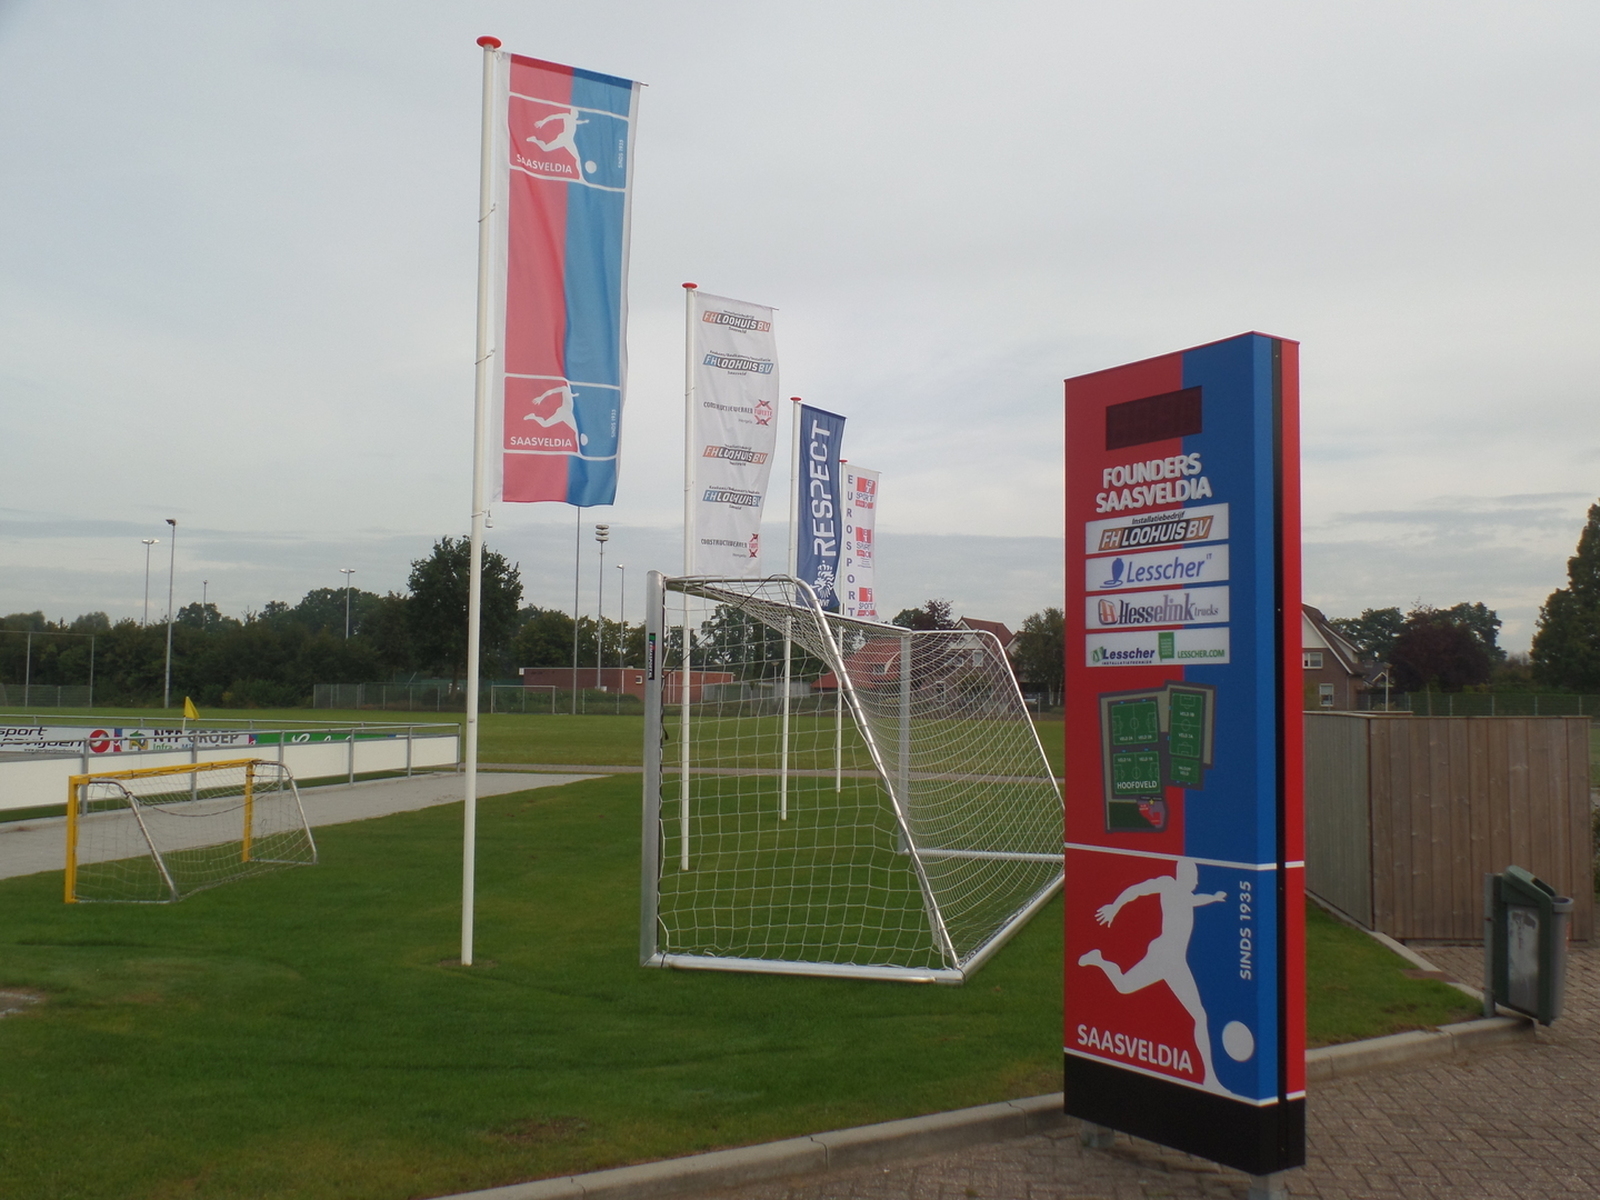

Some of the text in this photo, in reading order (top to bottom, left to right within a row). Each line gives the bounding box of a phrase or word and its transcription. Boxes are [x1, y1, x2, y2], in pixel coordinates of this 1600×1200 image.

[516, 154, 573, 174] SAASVELDIA
[510, 436, 572, 447] SAASVELDIA
[1103, 452, 1202, 489] FOUNDERS
[809, 419, 836, 556] RESPECT
[1096, 476, 1213, 514] SAASVELDIA
[1131, 511, 1186, 525] Installatiebedrijf
[1126, 556, 1205, 584] Lesscher
[1118, 593, 1219, 624] Hesselink trucks
[1103, 647, 1155, 660] Lesscher
[1177, 649, 1225, 659] LESSCHER.COM
[153, 729, 184, 743] NTP
[1117, 781, 1157, 789] HOOFDVELD
[1239, 881, 1252, 980] SINDS 1935
[1077, 1024, 1194, 1074] SAASVELDIA
